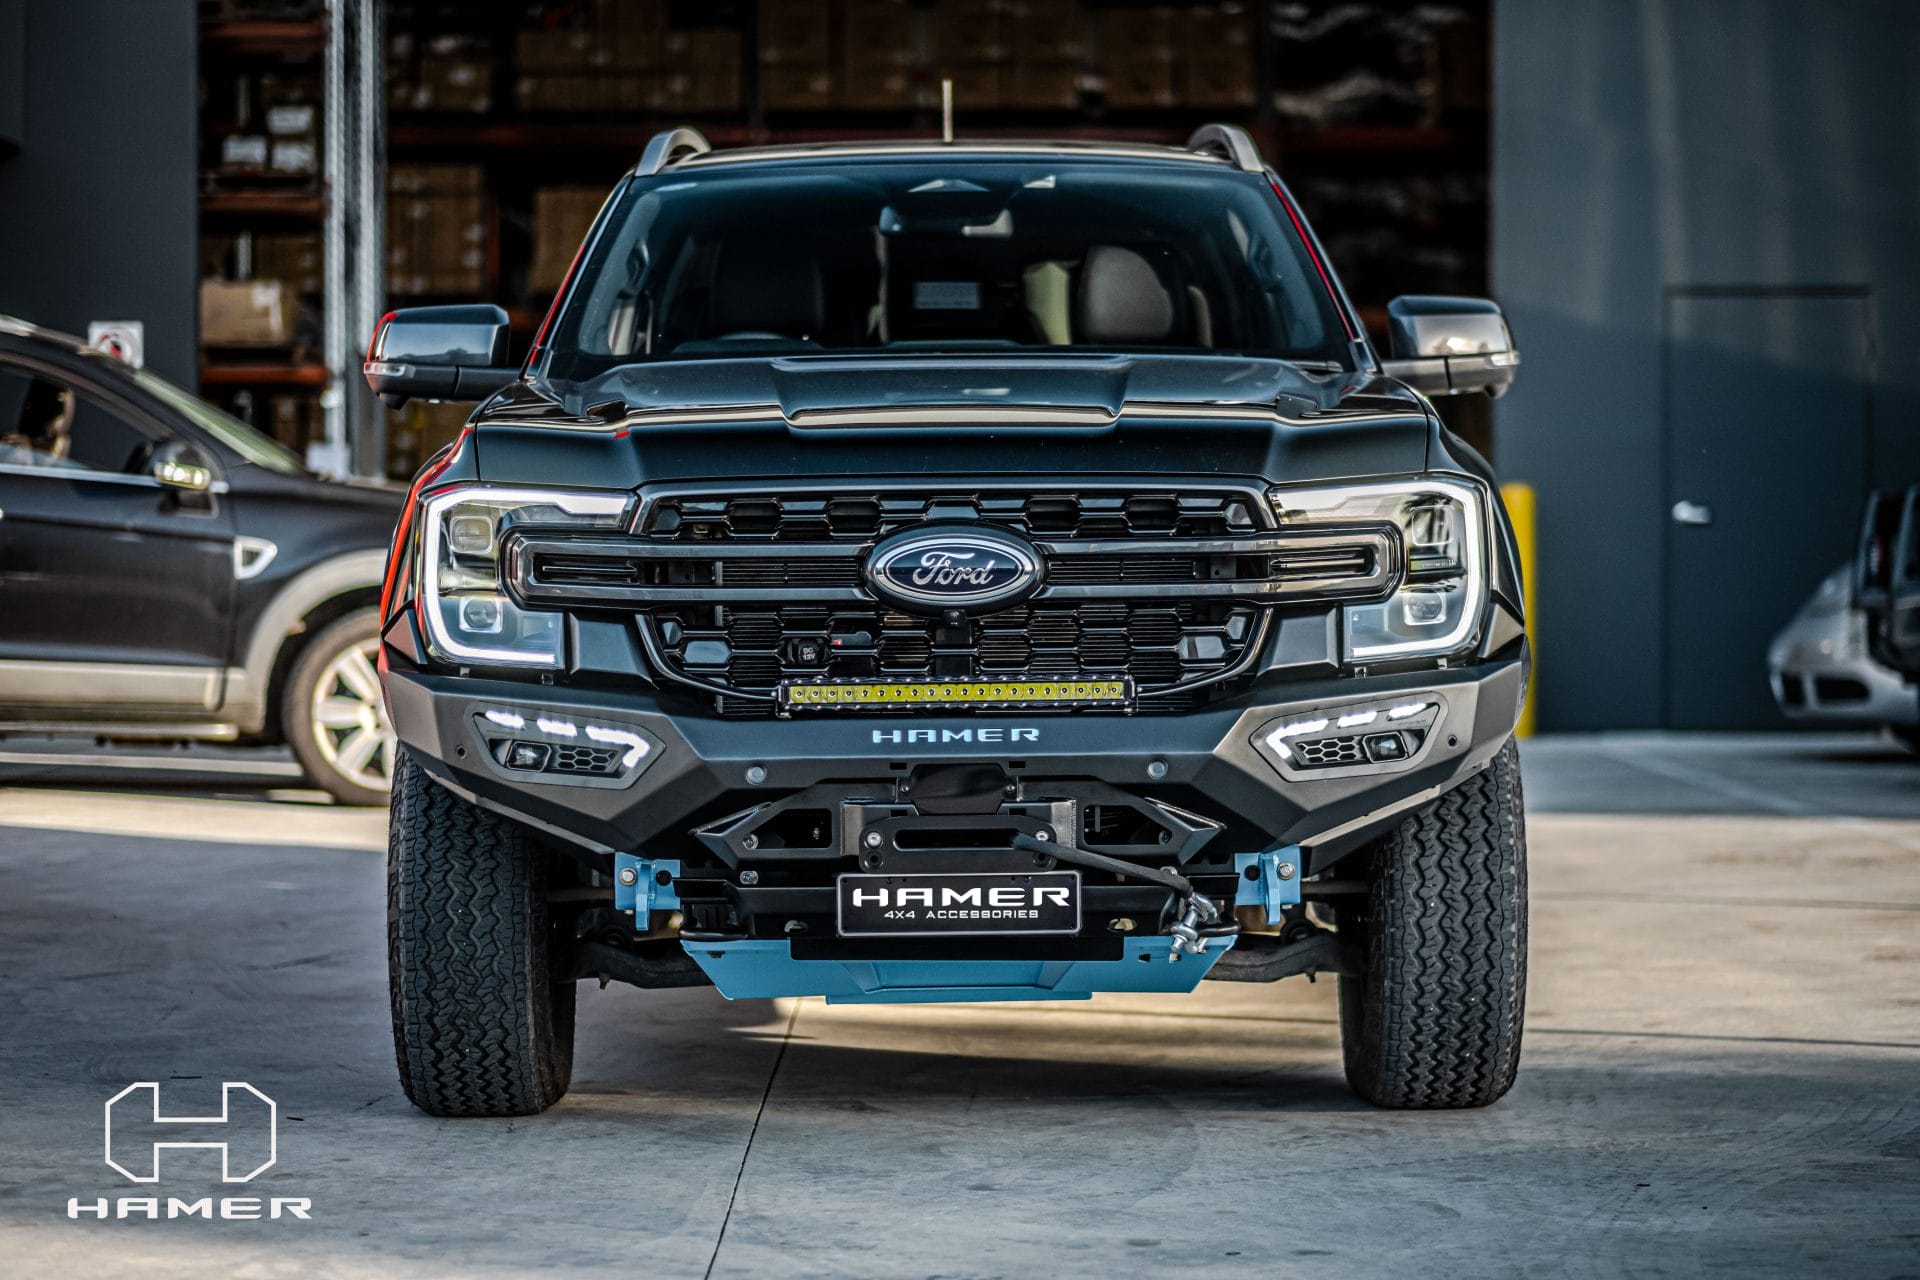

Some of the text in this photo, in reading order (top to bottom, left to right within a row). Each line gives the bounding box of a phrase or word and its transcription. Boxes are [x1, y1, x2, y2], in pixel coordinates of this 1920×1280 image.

[913, 551, 996, 585] Ford
[872, 728, 1040, 743] HAMER
[852, 887, 1070, 907] HAMER
[925, 910, 1039, 919] ACCESSORIES
